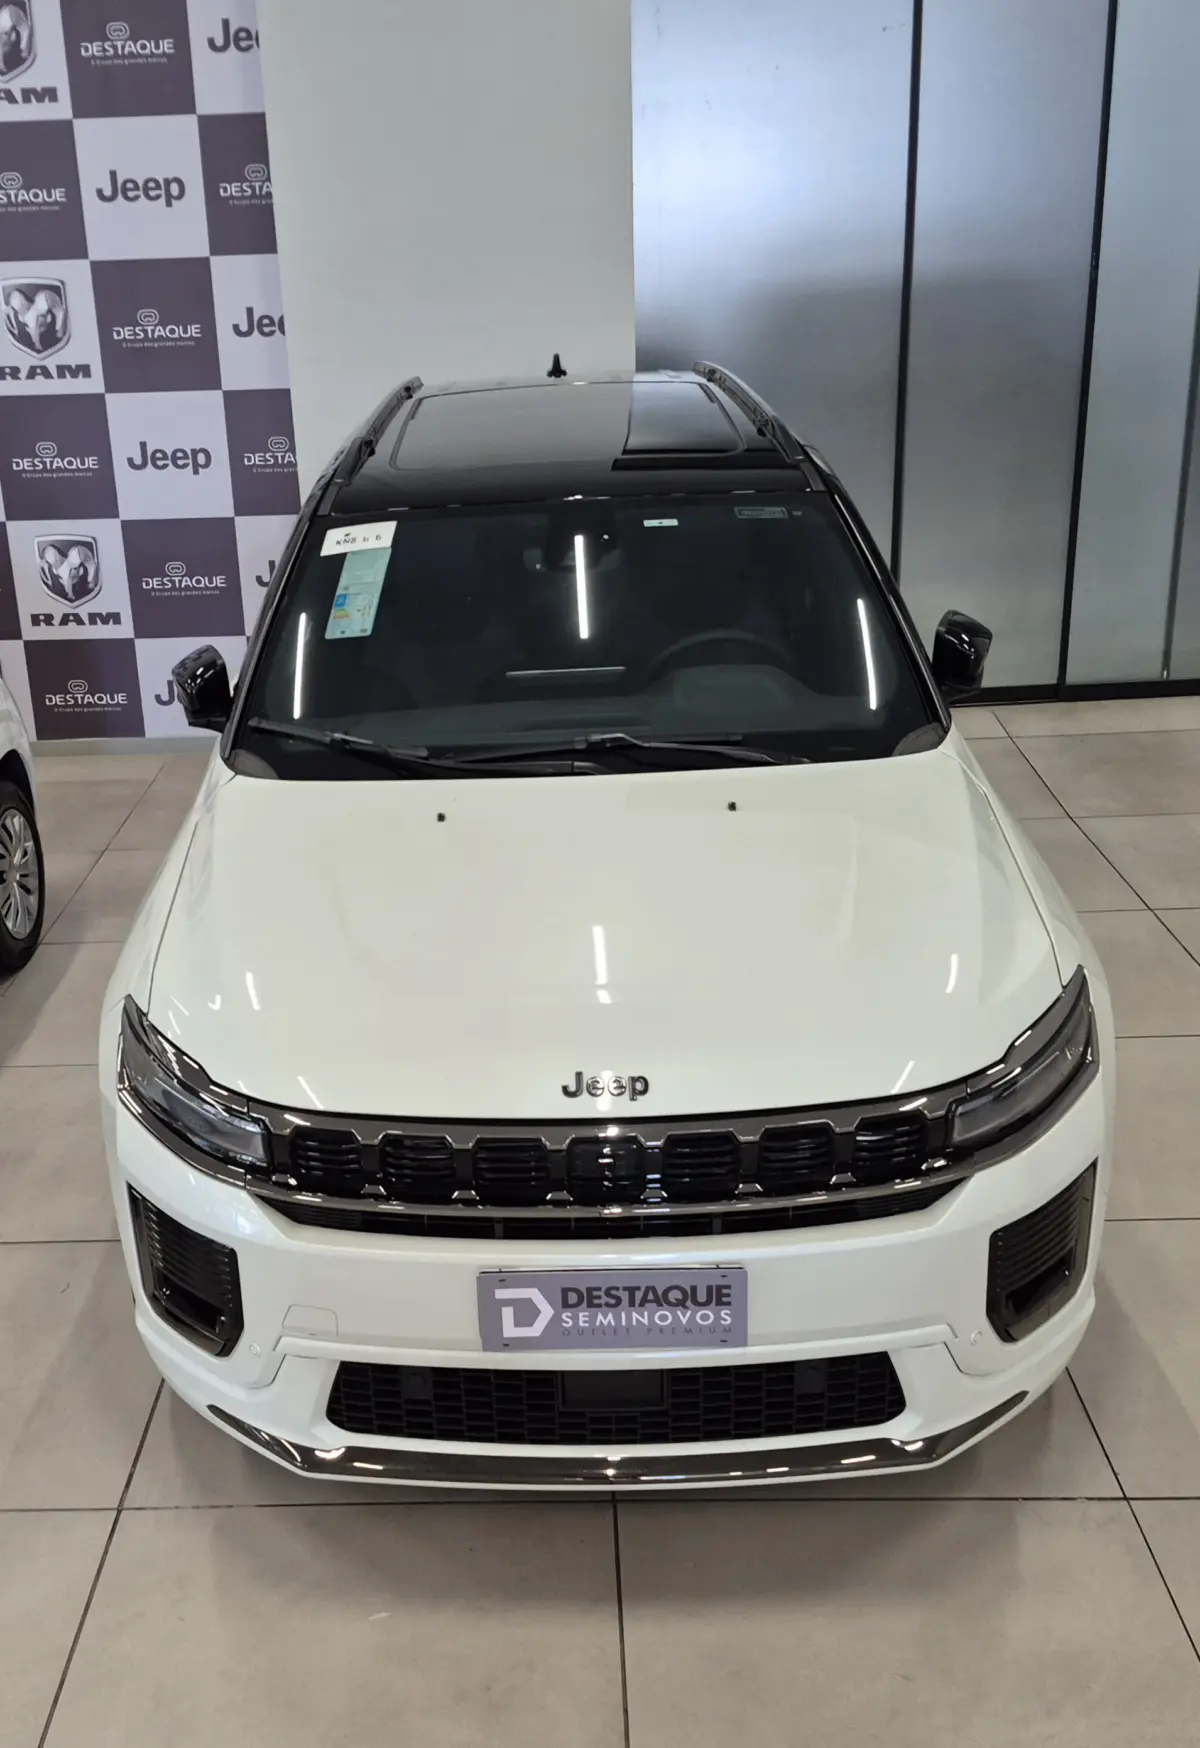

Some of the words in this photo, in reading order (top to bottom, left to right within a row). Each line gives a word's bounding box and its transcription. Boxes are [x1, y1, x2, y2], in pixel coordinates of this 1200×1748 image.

[207, 17, 260, 53] Je
[80, 38, 175, 57] DESTAQUE
[0, 86, 59, 105] AM
[0, 187, 67, 204] STAQUE
[96, 169, 186, 208] Jeep
[219, 181, 272, 197] DESTA
[232, 306, 286, 338] Je
[112, 324, 202, 340] DESTAQUE
[0, 363, 92, 381] RAM
[12, 456, 99, 470] DESTAQUE
[126, 441, 212, 476] Jeep
[243, 452, 296, 465] DESTA
[142, 575, 227, 589] DESTAQUE
[30, 611, 122, 627] RAM
[45, 692, 128, 706] DESTAQUE
[561, 1071, 650, 1102] Jeep
[560, 1284, 732, 1309] DESTAQUE
[561, 1309, 732, 1327] SEMINOVOS
[562, 1327, 630, 1336] OUTLET
[648, 1326, 732, 1335] PREMIUM
